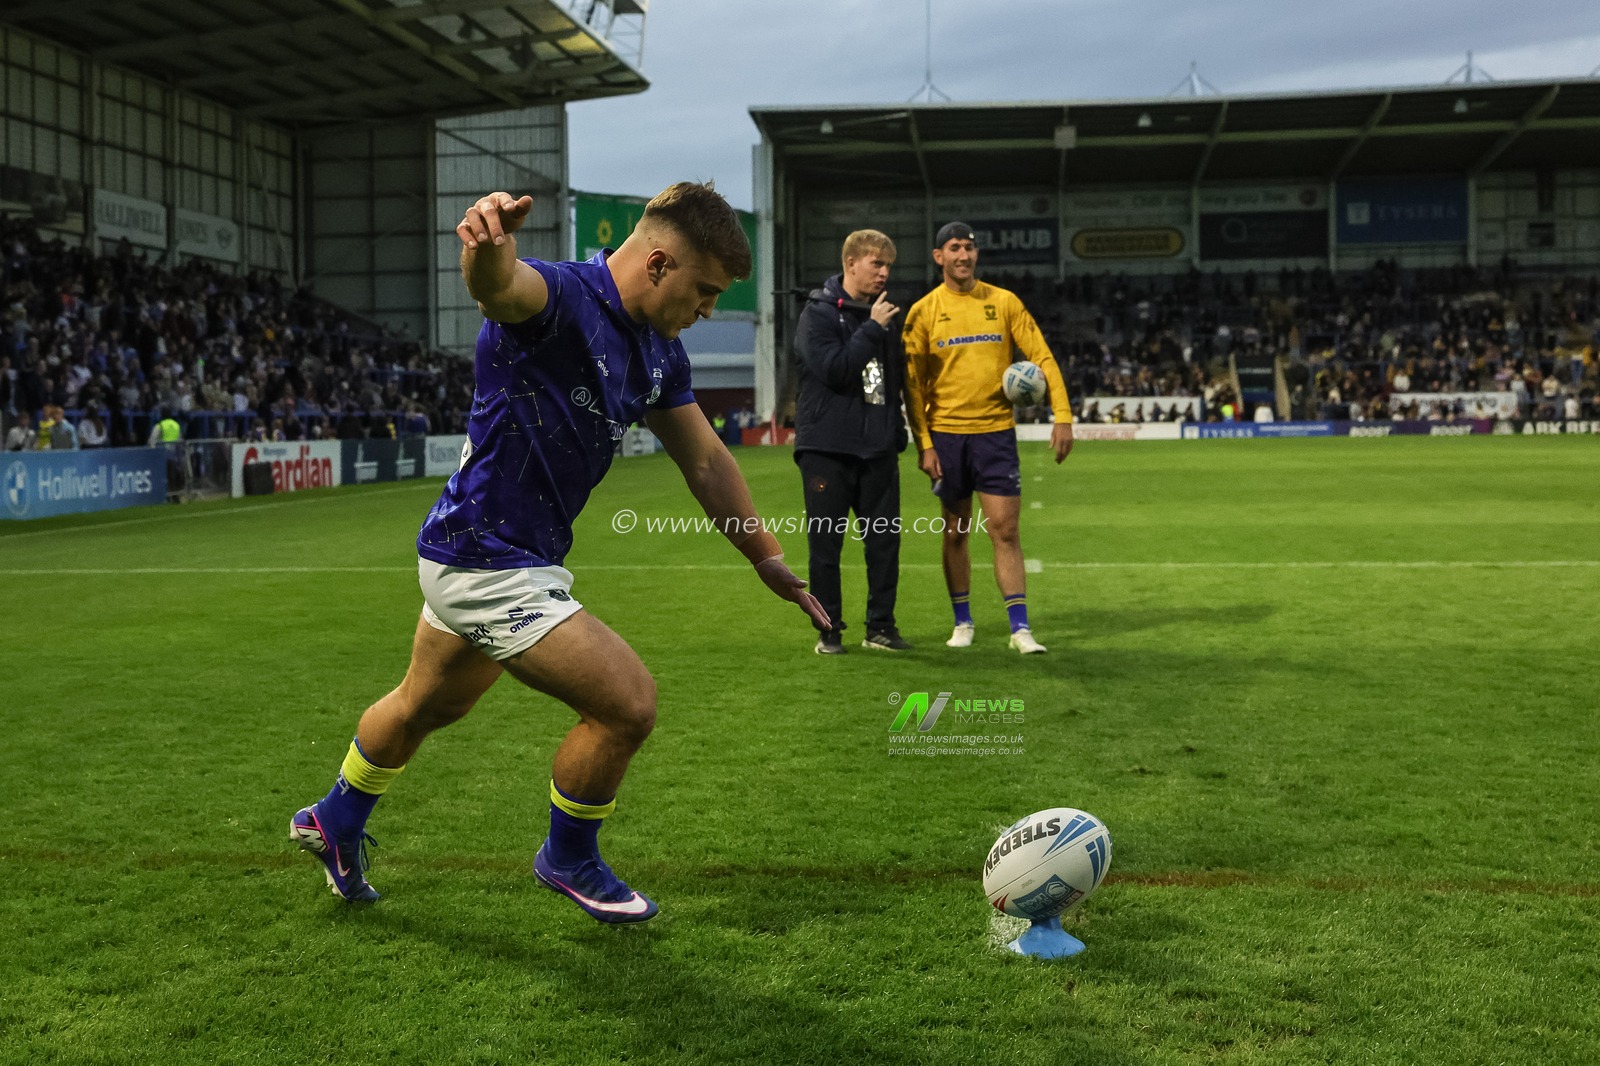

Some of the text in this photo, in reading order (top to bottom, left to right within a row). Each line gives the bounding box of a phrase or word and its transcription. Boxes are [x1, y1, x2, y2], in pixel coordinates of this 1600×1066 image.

[110, 465, 153, 498] Jones
[244, 444, 332, 492] ardian
[985, 818, 1061, 877] STEEDEN
